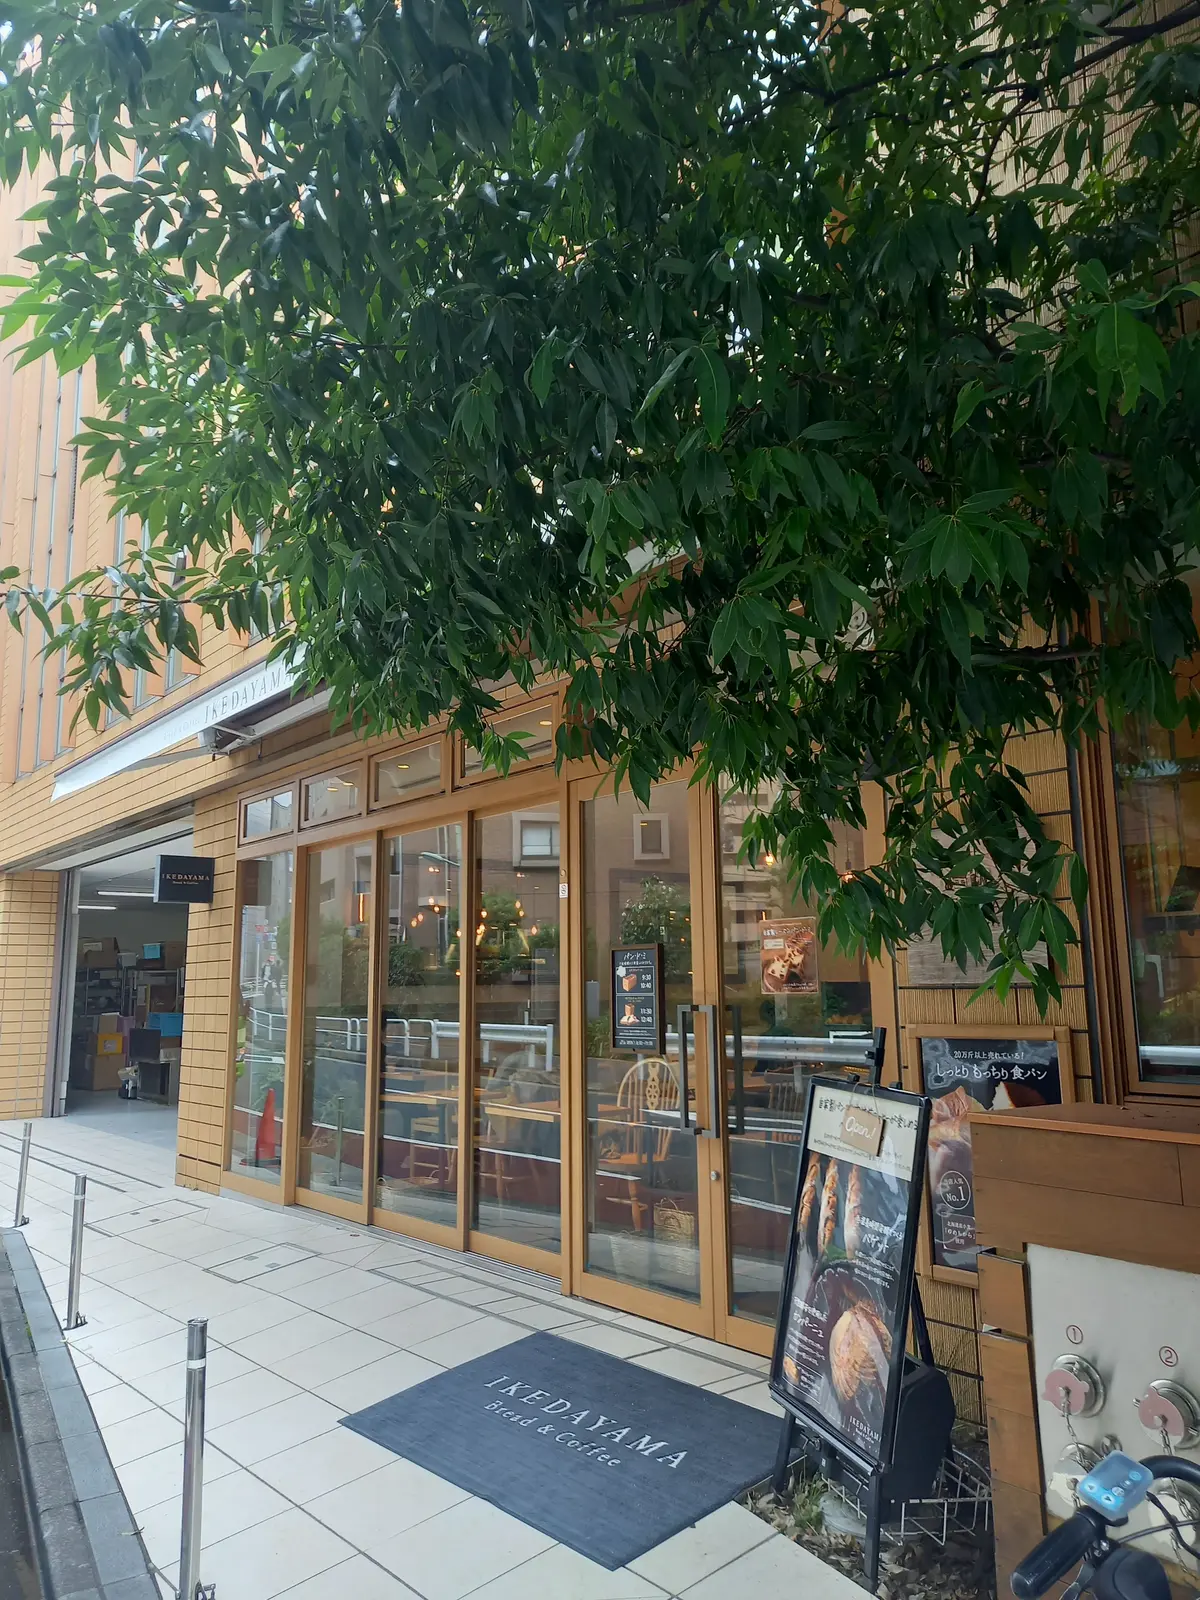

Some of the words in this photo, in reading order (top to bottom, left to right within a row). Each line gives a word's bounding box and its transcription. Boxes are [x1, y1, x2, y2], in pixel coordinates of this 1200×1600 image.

[162, 873, 210, 881] IKEDAYAMA
[845, 1116, 876, 1139] Open!
[946, 1186, 966, 1202] No.1
[483, 1375, 688, 1469] IKEDAYAMA
[484, 1400, 538, 1427] Bread
[537, 1424, 555, 1435] &
[555, 1432, 621, 1467] Coffee
